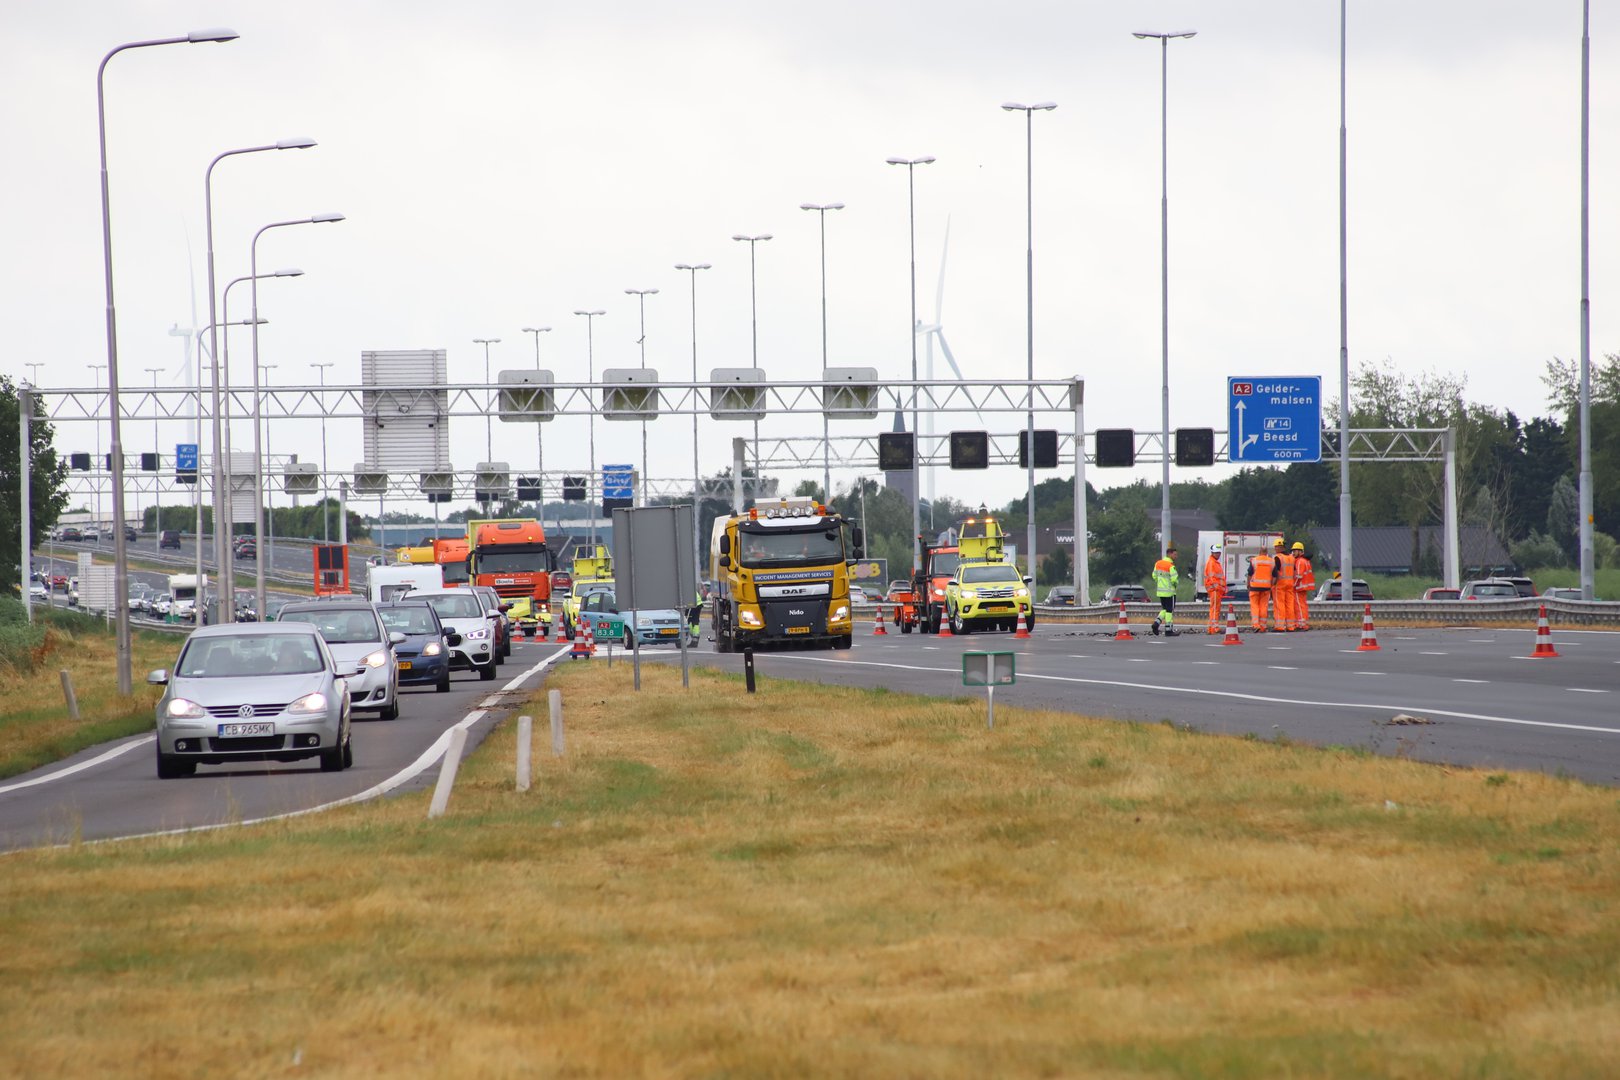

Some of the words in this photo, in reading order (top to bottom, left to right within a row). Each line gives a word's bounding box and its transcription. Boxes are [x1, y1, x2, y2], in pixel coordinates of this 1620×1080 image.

[1235, 386, 1250, 394] A2
[1256, 385, 1300, 393] Gelder-
[1270, 396, 1313, 405] malsen
[1263, 433, 1298, 441] Beesd
[777, 572, 811, 580] MANAGEMENT
[225, 725, 238, 735] CB
